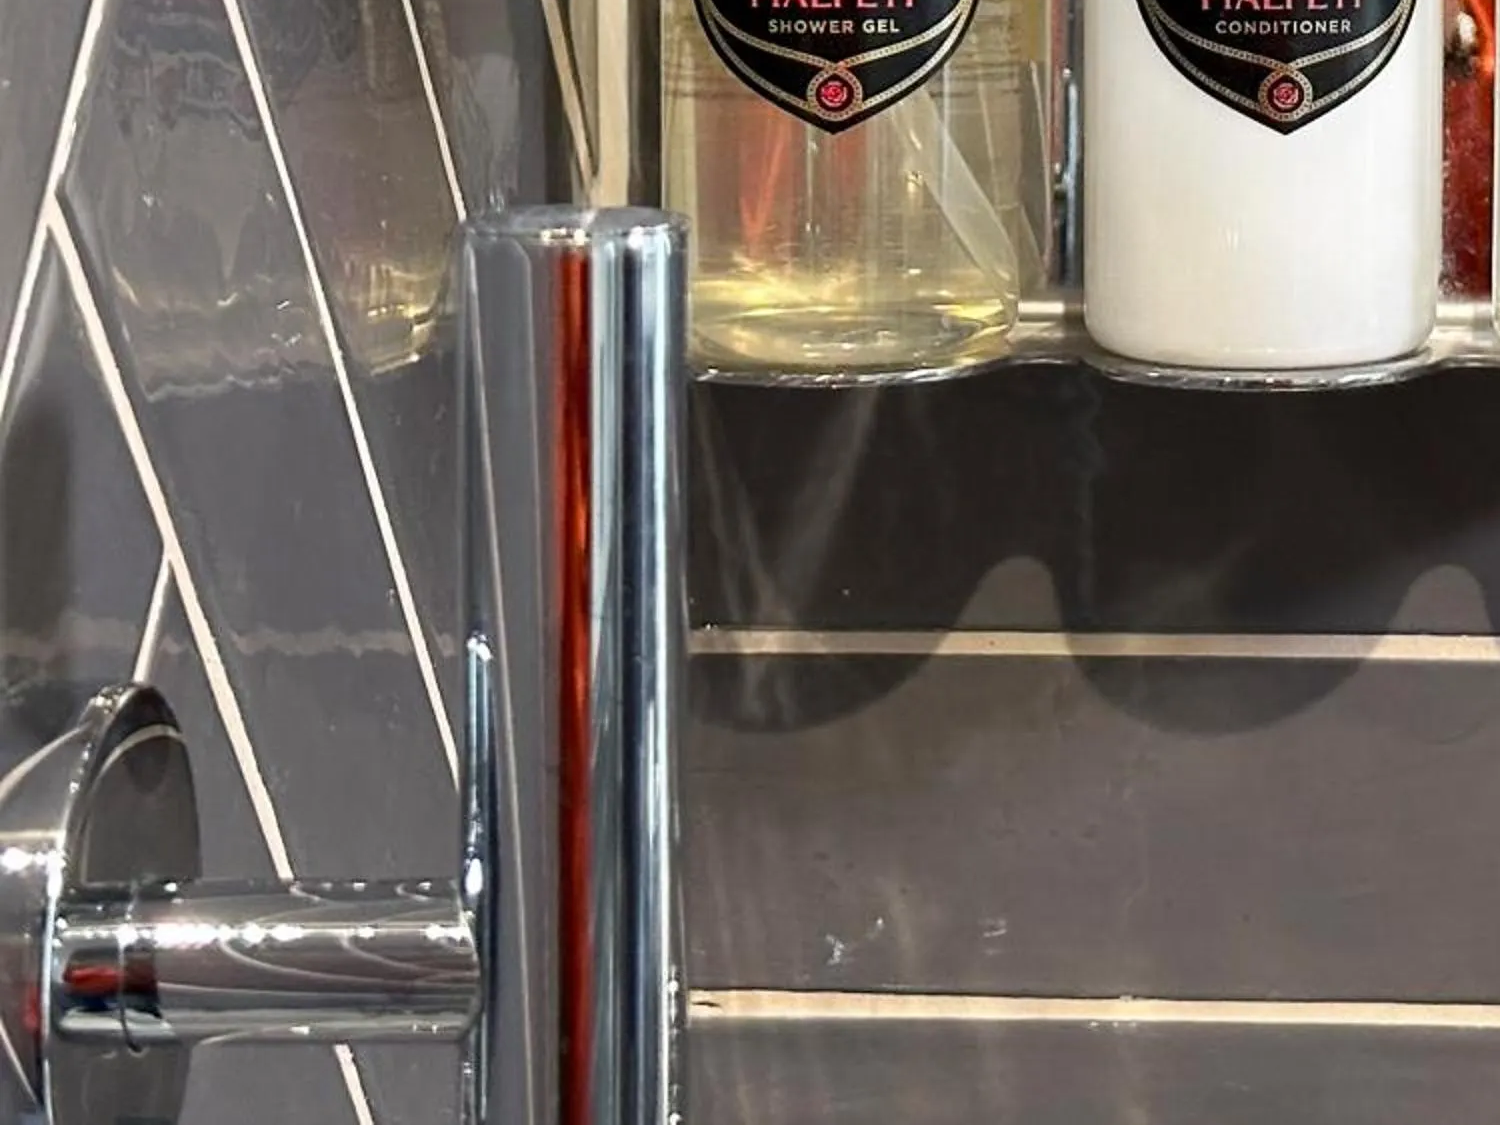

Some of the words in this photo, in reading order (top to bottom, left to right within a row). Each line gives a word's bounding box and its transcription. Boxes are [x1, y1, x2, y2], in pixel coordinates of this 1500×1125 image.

[767, 18, 854, 34] SHOWER
[862, 18, 900, 34] GEL
[1214, 18, 1352, 35] CONDITIONER
